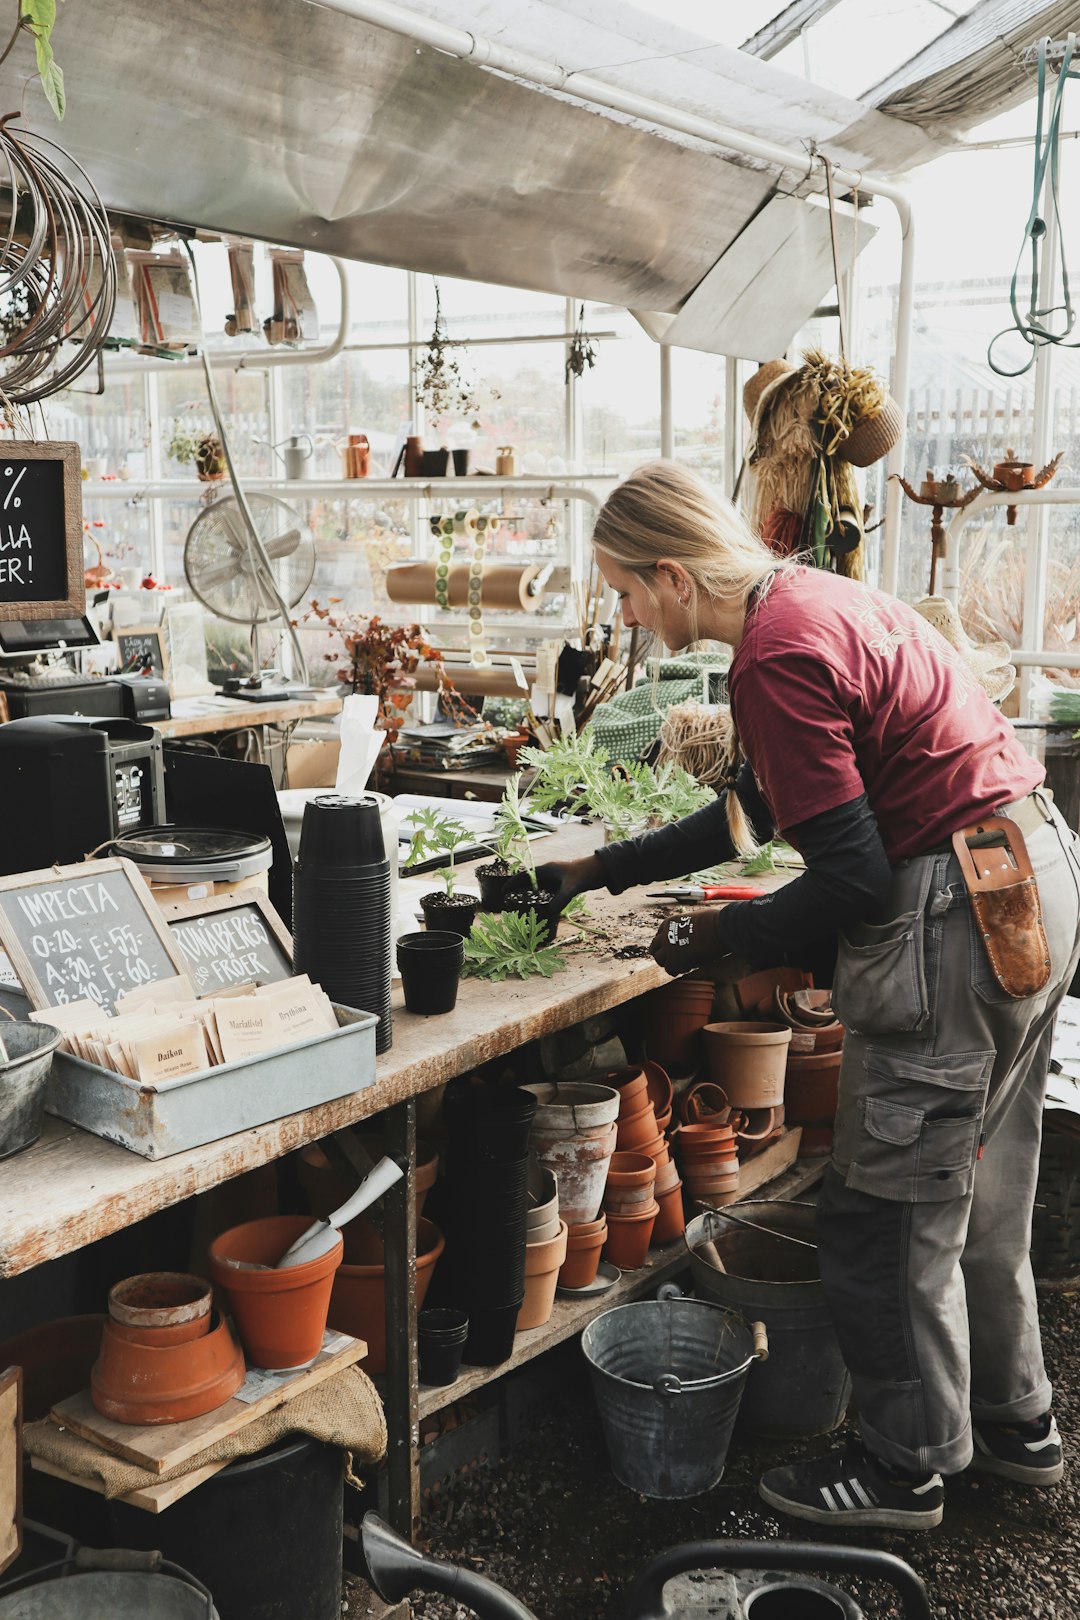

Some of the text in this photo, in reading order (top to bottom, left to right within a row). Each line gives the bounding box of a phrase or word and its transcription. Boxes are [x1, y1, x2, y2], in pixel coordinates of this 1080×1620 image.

[17, 882, 119, 927] IMPECTA
[210, 952, 270, 983] FRÖER
[157, 1048, 183, 1062] Daikon
